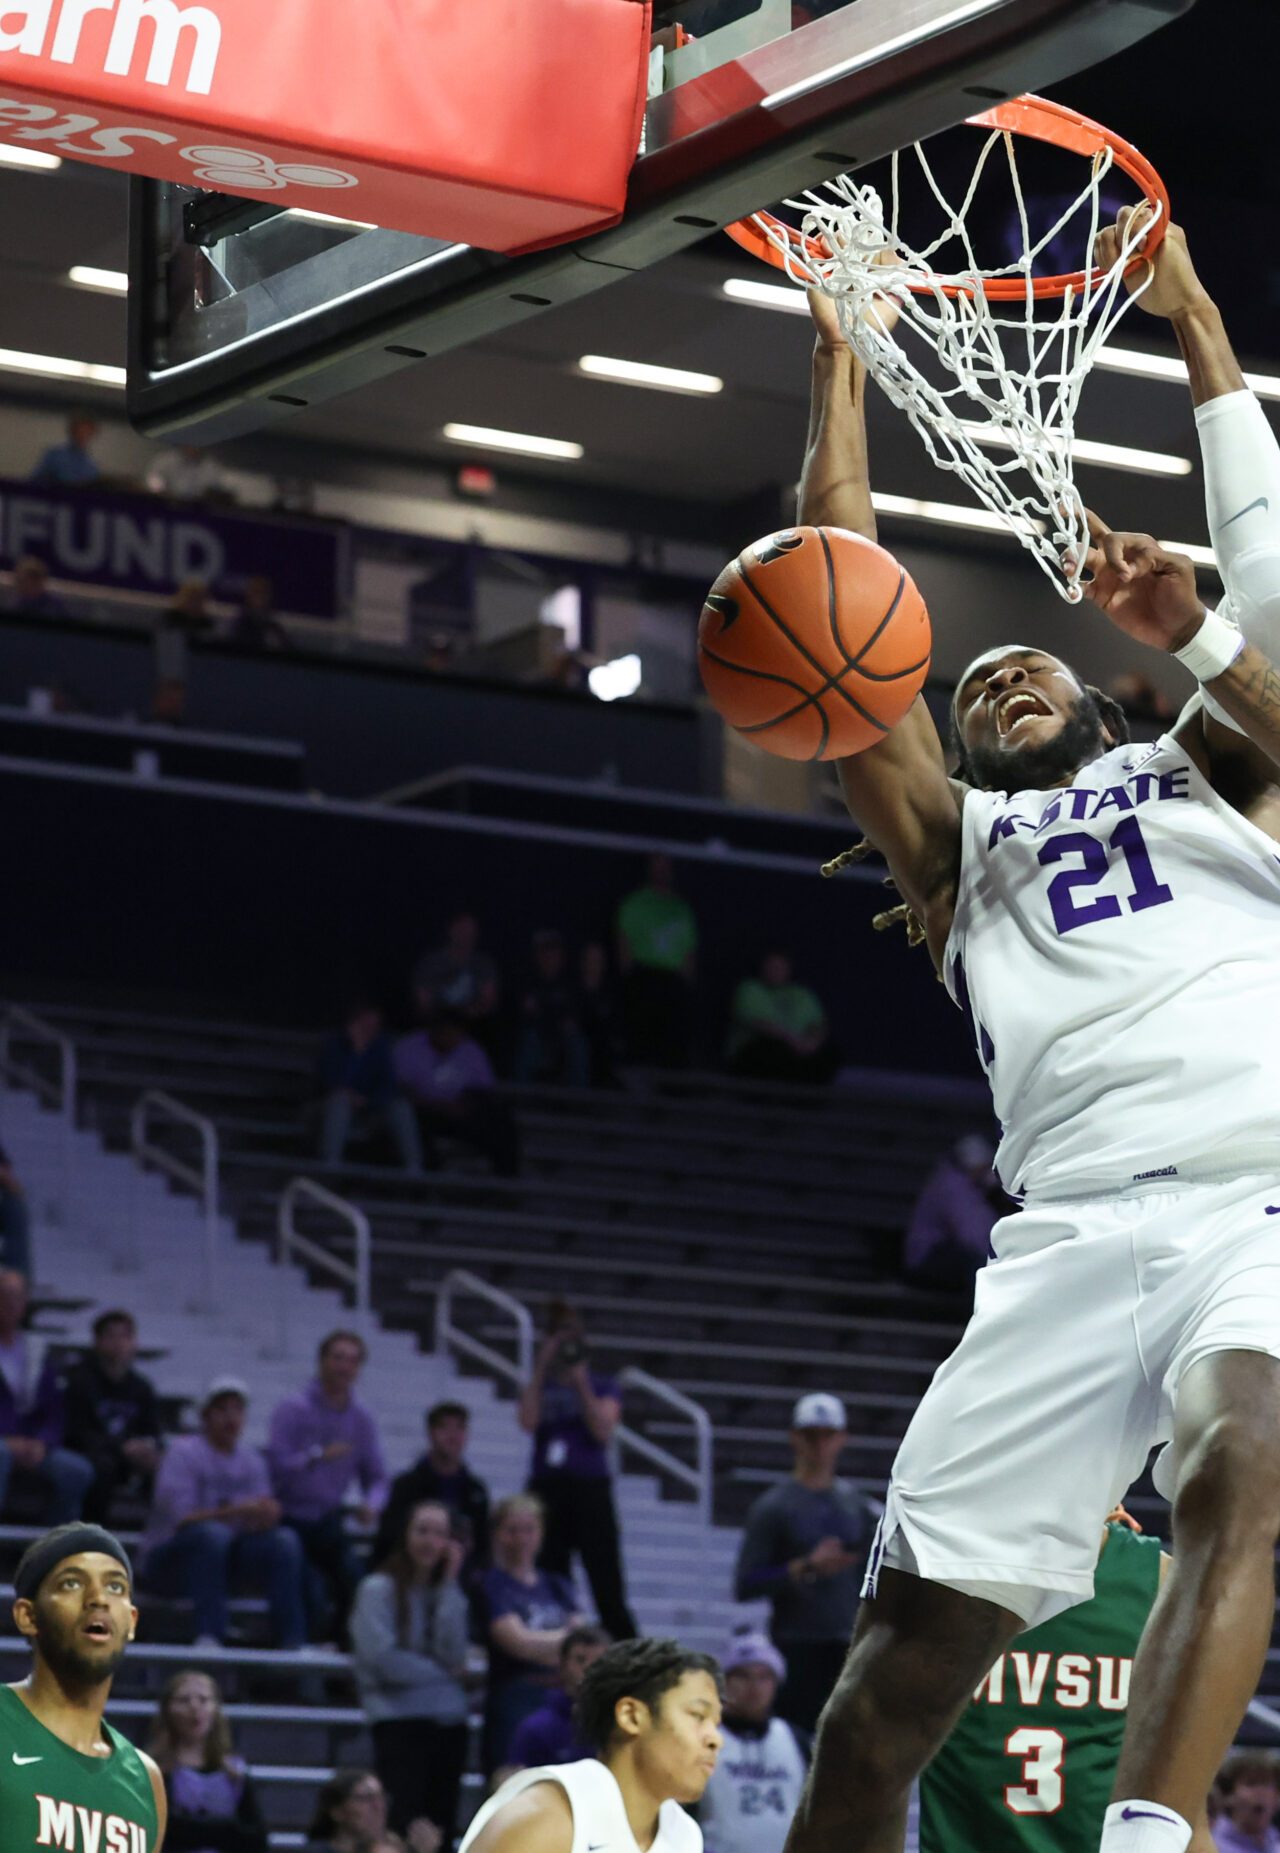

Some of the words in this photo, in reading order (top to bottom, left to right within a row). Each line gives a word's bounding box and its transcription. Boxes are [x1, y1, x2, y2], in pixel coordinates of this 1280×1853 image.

[7, 498, 226, 584] FUND
[1037, 814, 1174, 936] 21
[1004, 1725, 1067, 1816] 3
[34, 1793, 147, 1853] MVSU
